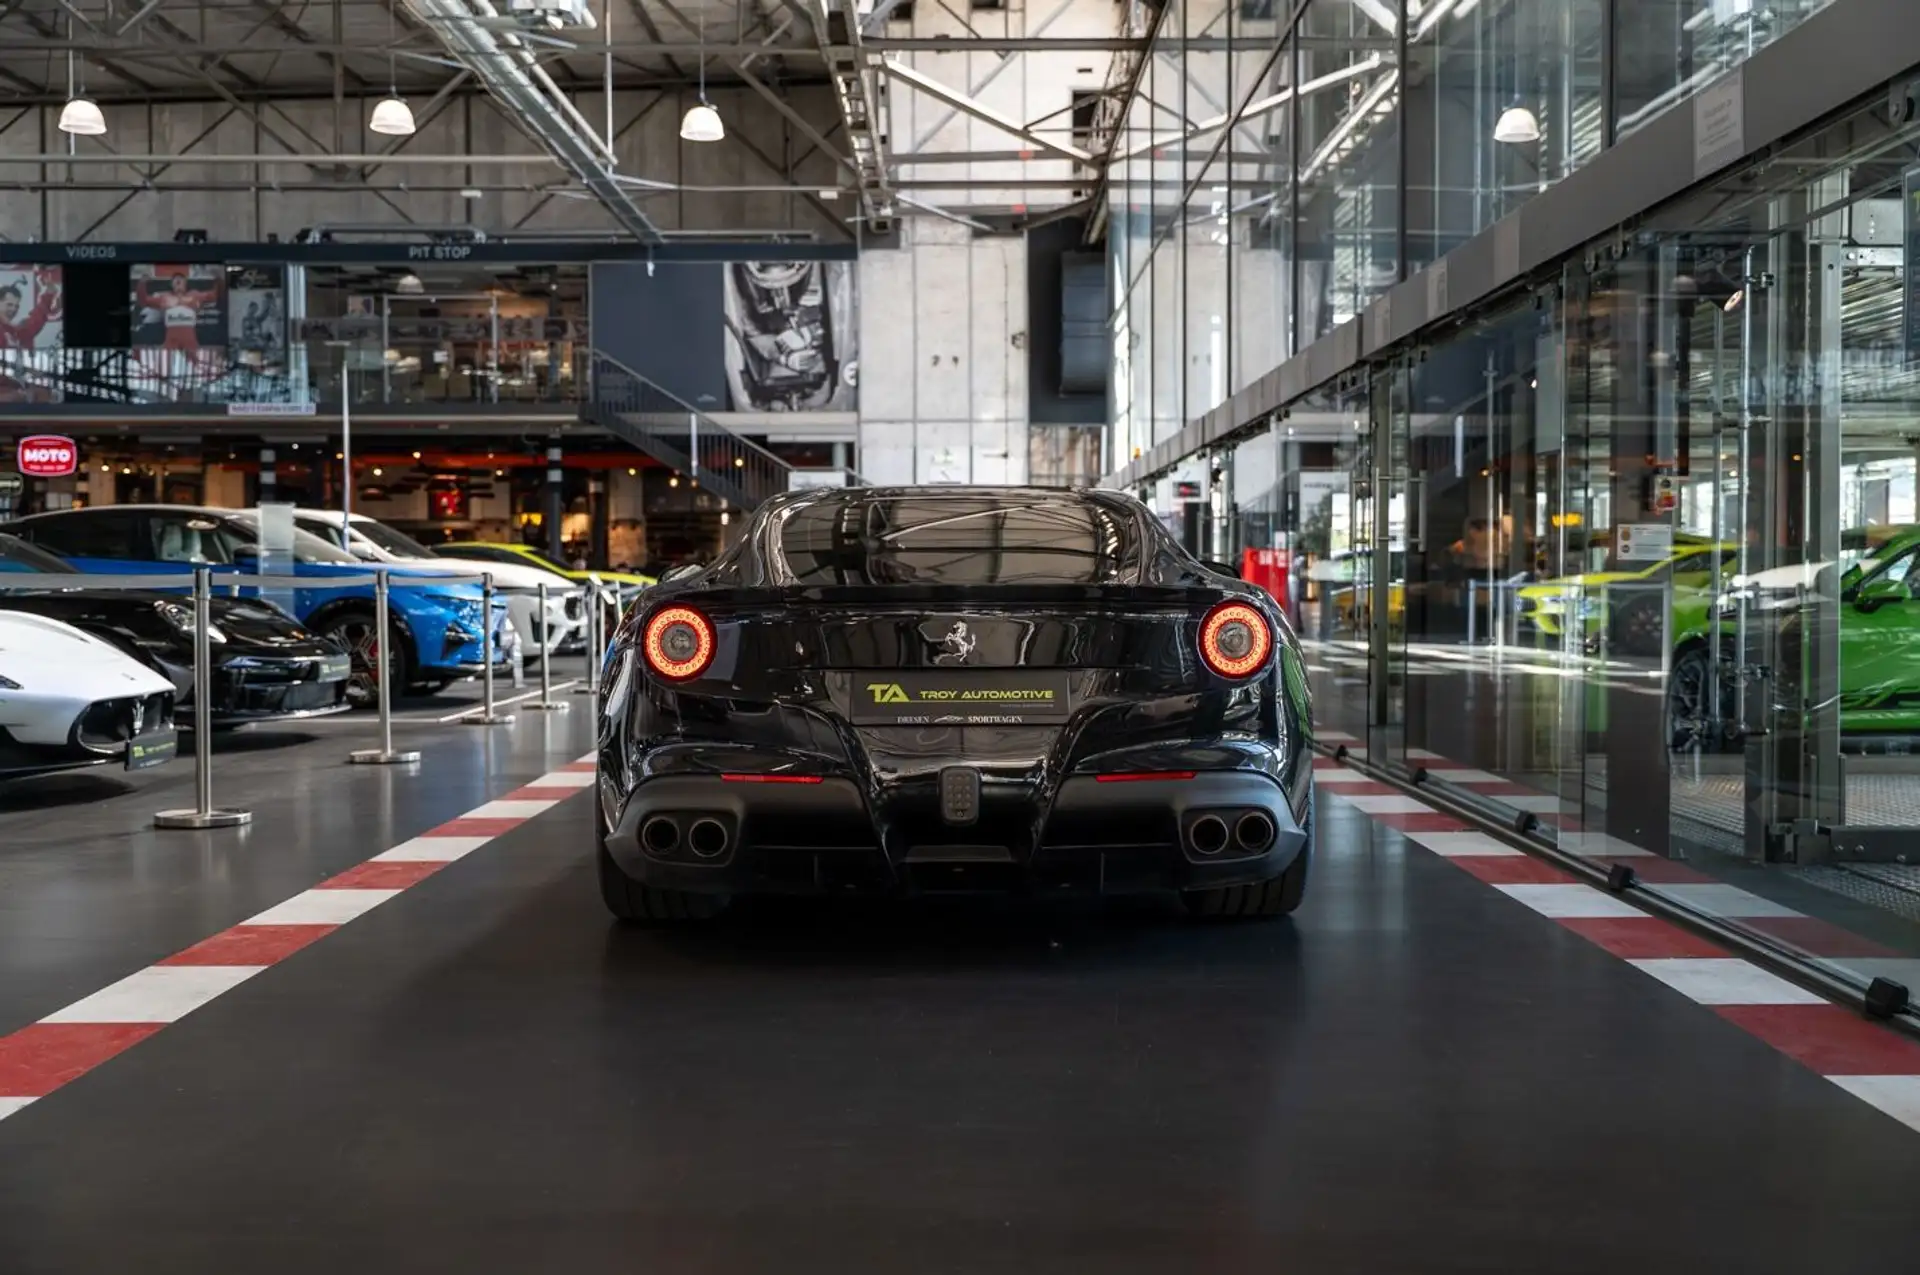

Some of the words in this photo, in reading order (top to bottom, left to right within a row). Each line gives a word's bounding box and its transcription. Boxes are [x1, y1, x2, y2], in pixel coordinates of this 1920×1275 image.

[65, 245, 117, 259] VIDEOS
[409, 245, 430, 259] PIT
[434, 245, 471, 259] STOP
[23, 448, 71, 463] MOTO
[866, 683, 911, 703] TA
[919, 690, 957, 699] TROY
[961, 690, 1054, 699] AUTOMOTIVE
[967, 715, 1024, 725] SPORTWAGEN
